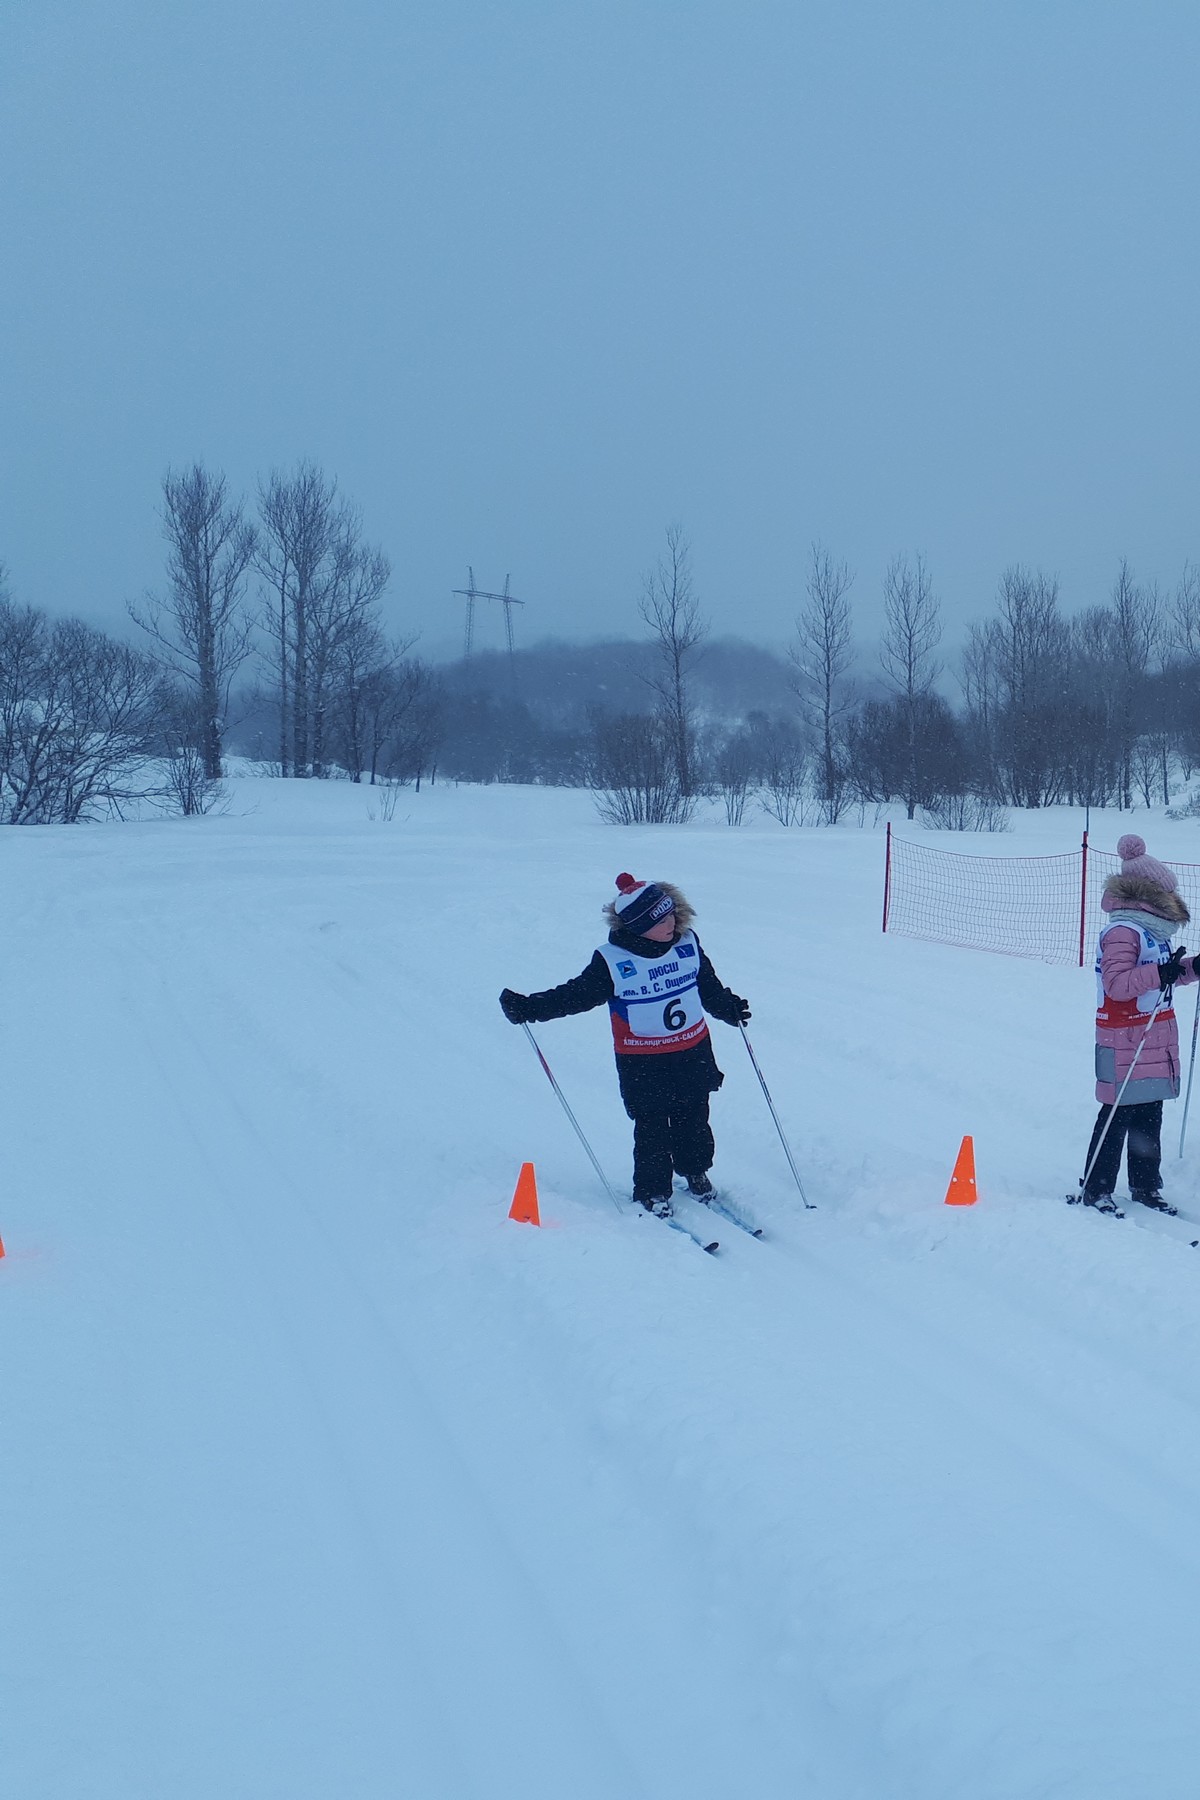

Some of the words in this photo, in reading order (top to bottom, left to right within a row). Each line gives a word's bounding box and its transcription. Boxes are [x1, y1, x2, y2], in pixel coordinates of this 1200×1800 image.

[648, 961, 679, 981] ДЮСШ
[640, 985, 651, 995] В.
[653, 982, 664, 993] С.
[662, 998, 687, 1032] 6
